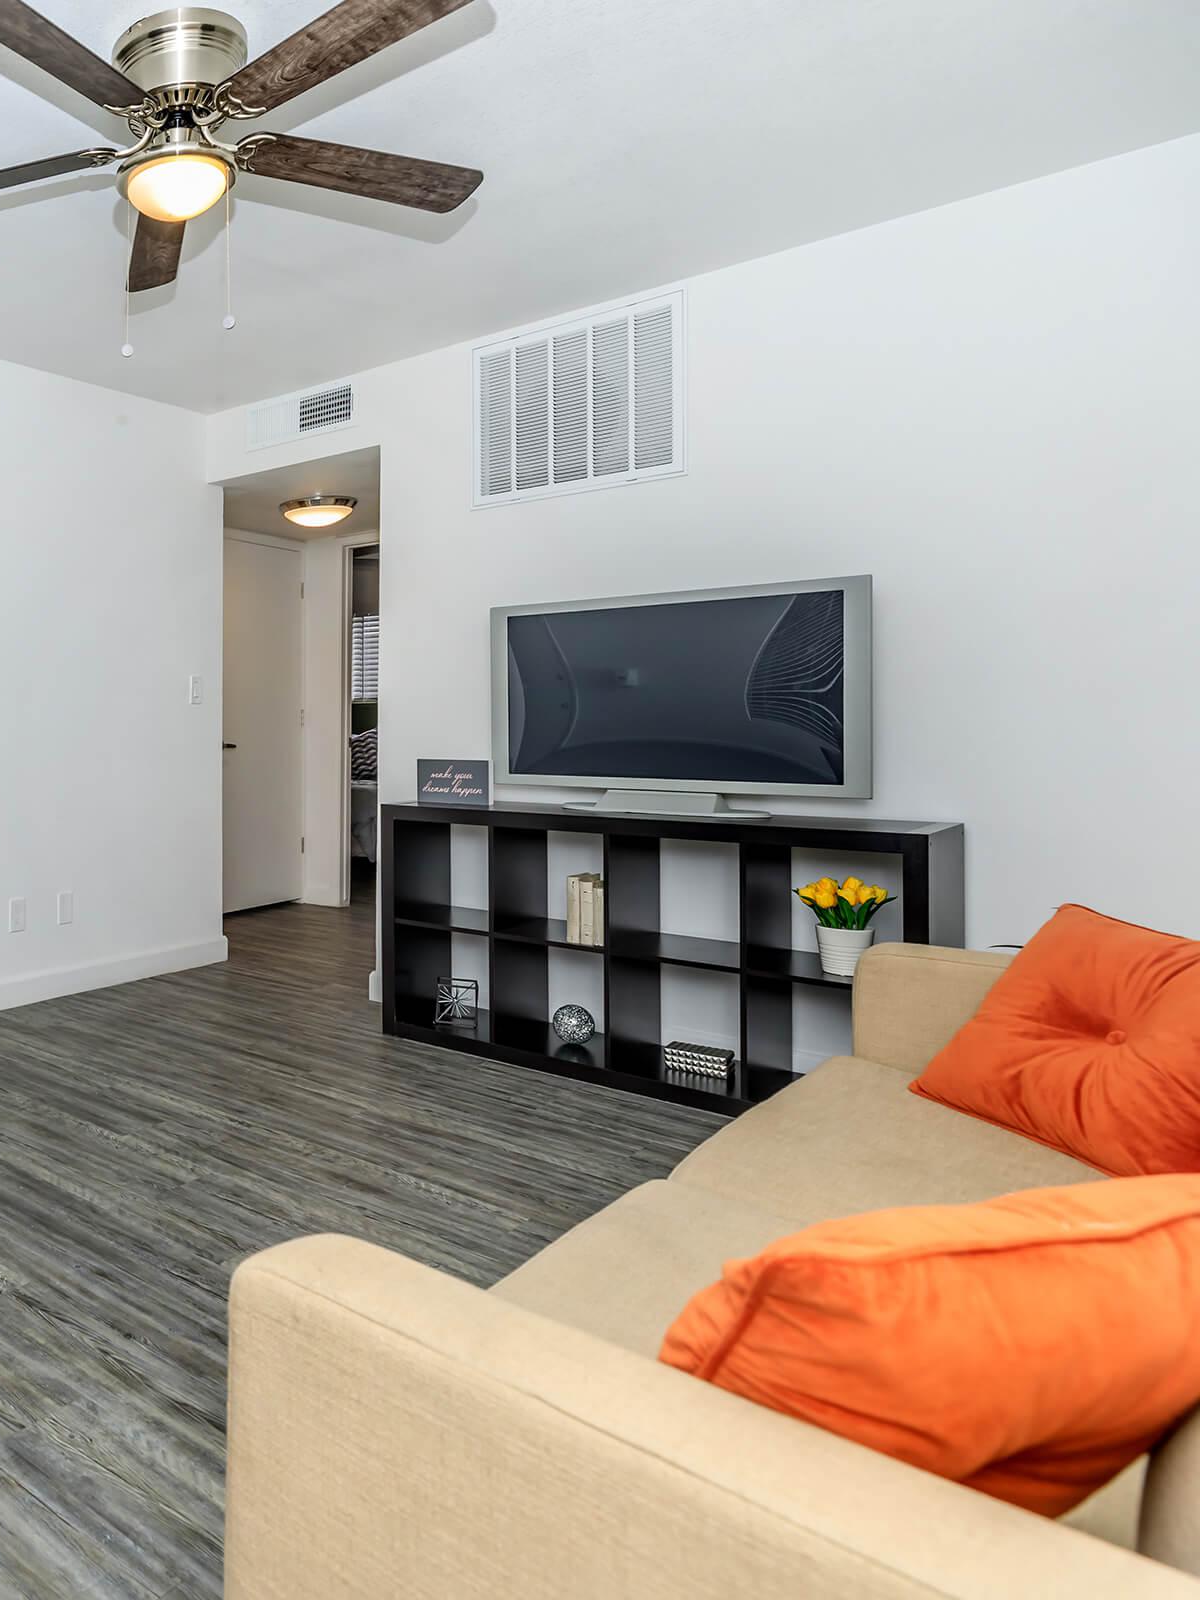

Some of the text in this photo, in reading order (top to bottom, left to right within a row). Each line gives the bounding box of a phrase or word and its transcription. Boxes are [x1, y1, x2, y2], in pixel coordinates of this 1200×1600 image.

[430, 764, 473, 786] make your
[422, 780, 483, 797] dreams happen
